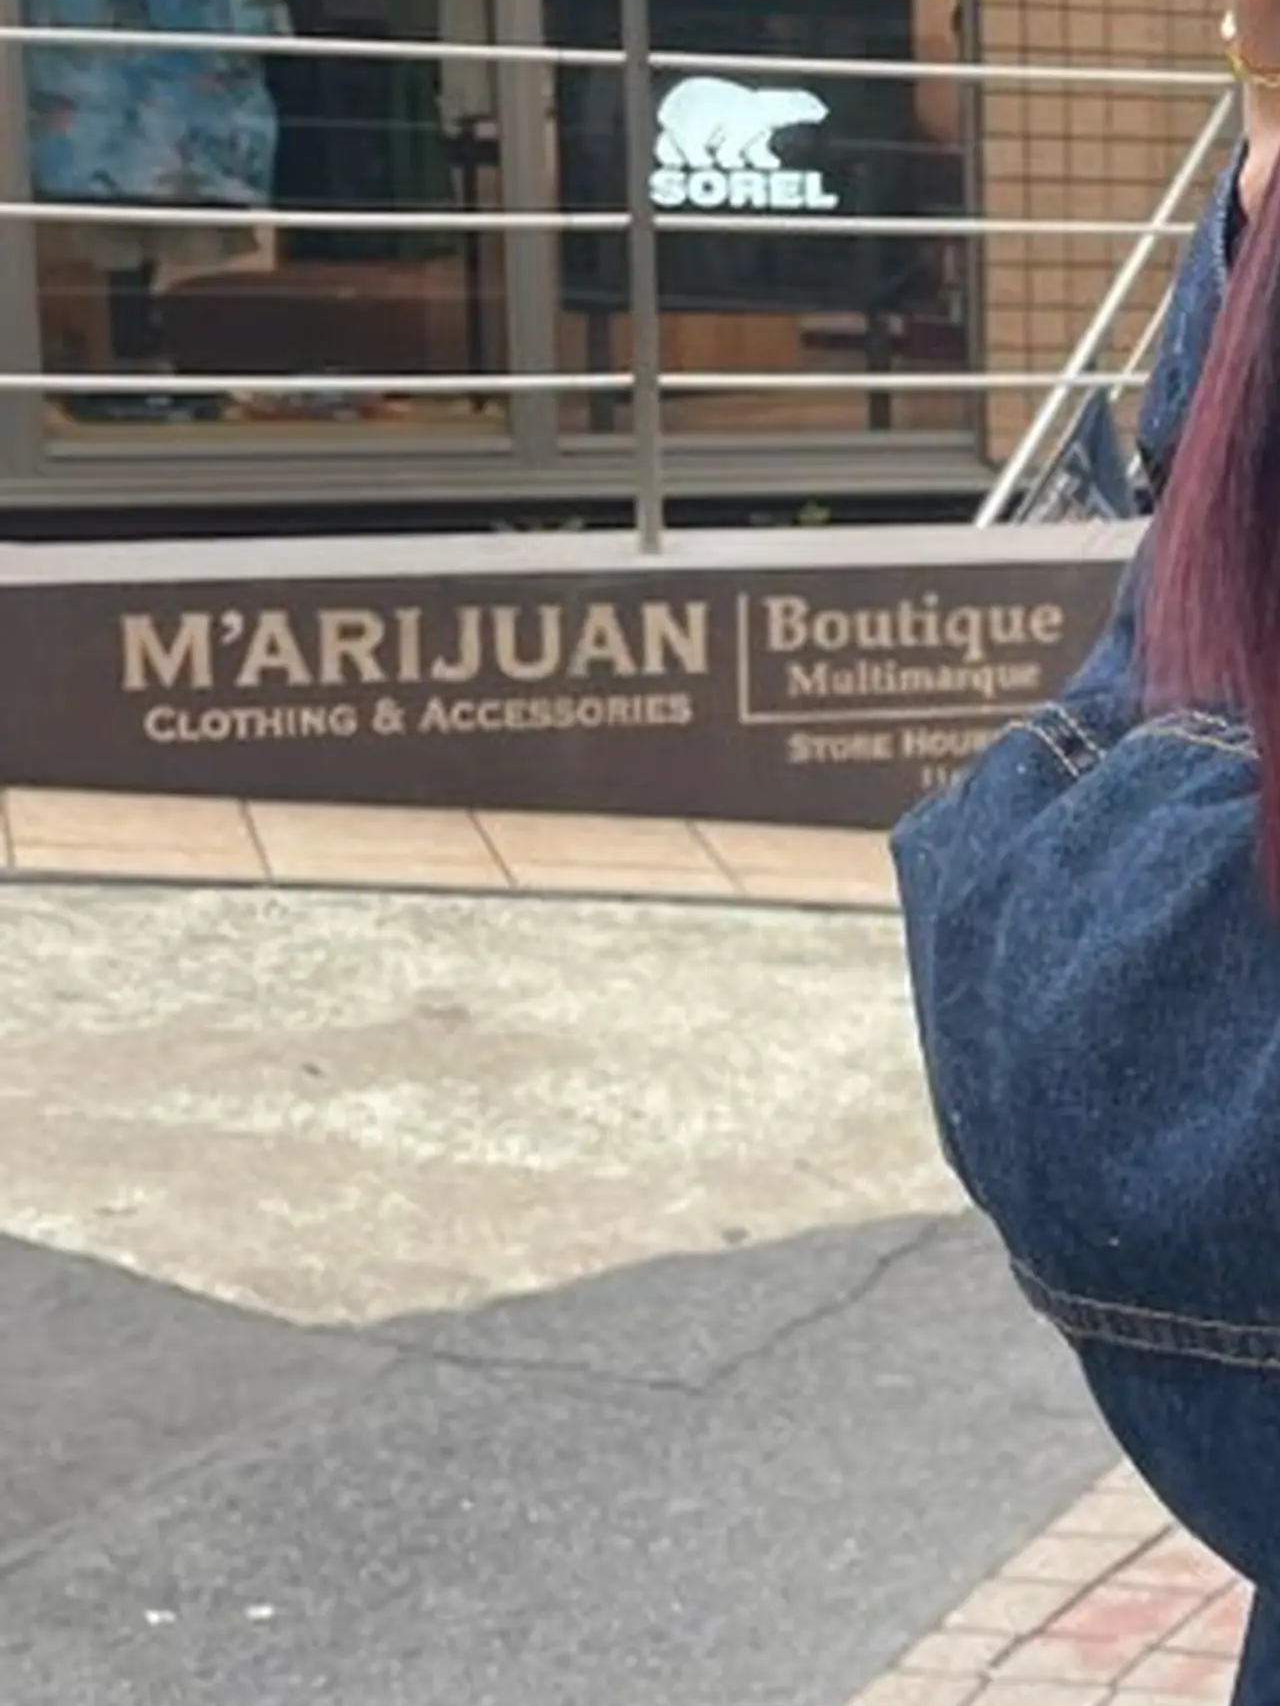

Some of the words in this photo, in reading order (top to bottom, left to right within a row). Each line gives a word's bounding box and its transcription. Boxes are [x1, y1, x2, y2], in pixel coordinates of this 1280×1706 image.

[649, 170, 838, 209] SOREL
[766, 591, 1064, 663] Boutique
[787, 659, 1042, 700] Multimarque
[144, 702, 359, 743] CLOTHING
[373, 697, 406, 734] &
[420, 693, 693, 734] ACCESSORIES
